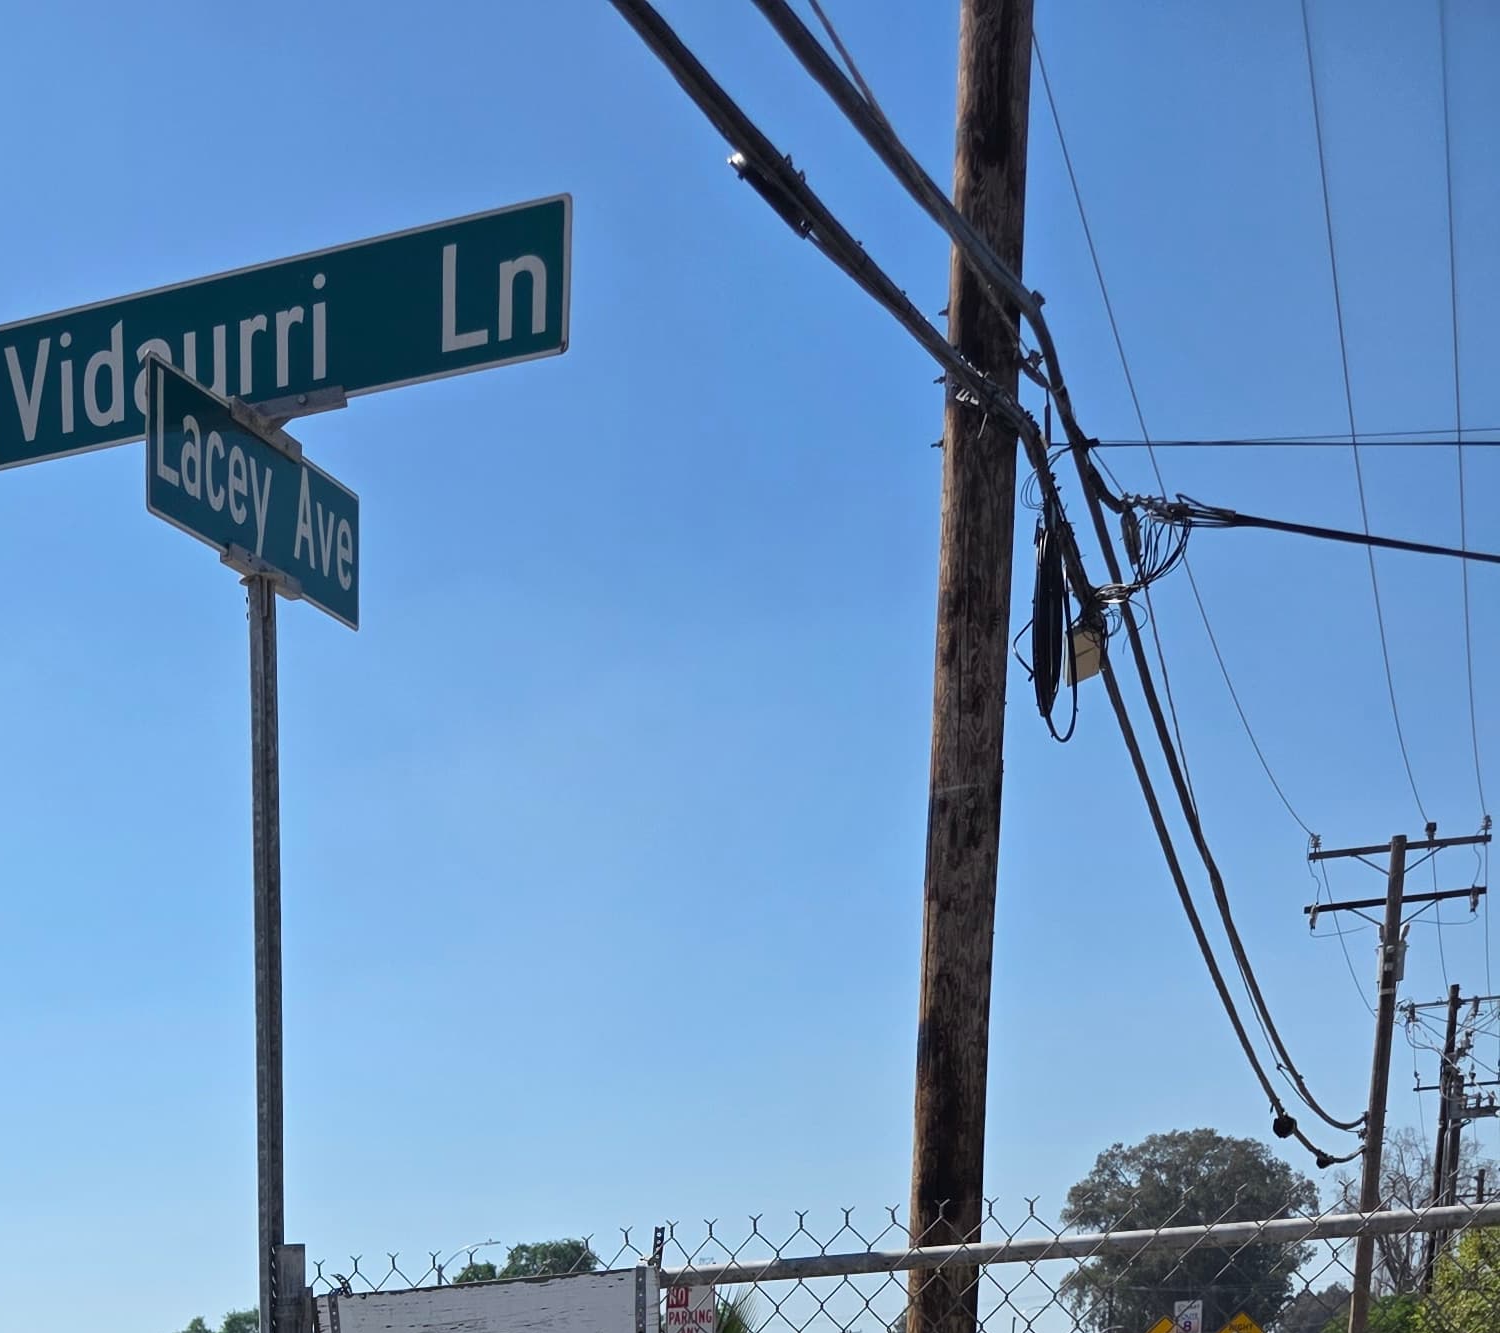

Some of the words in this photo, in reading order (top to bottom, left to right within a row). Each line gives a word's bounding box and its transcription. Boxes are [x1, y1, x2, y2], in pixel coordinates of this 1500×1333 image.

[3, 274, 327, 442] Vidaurri
[442, 243, 547, 353] Ln
[156, 365, 273, 559] Lacey
[294, 466, 353, 591] Ave
[669, 1286, 686, 1305] NO
[1183, 1320, 1192, 1332] 8
